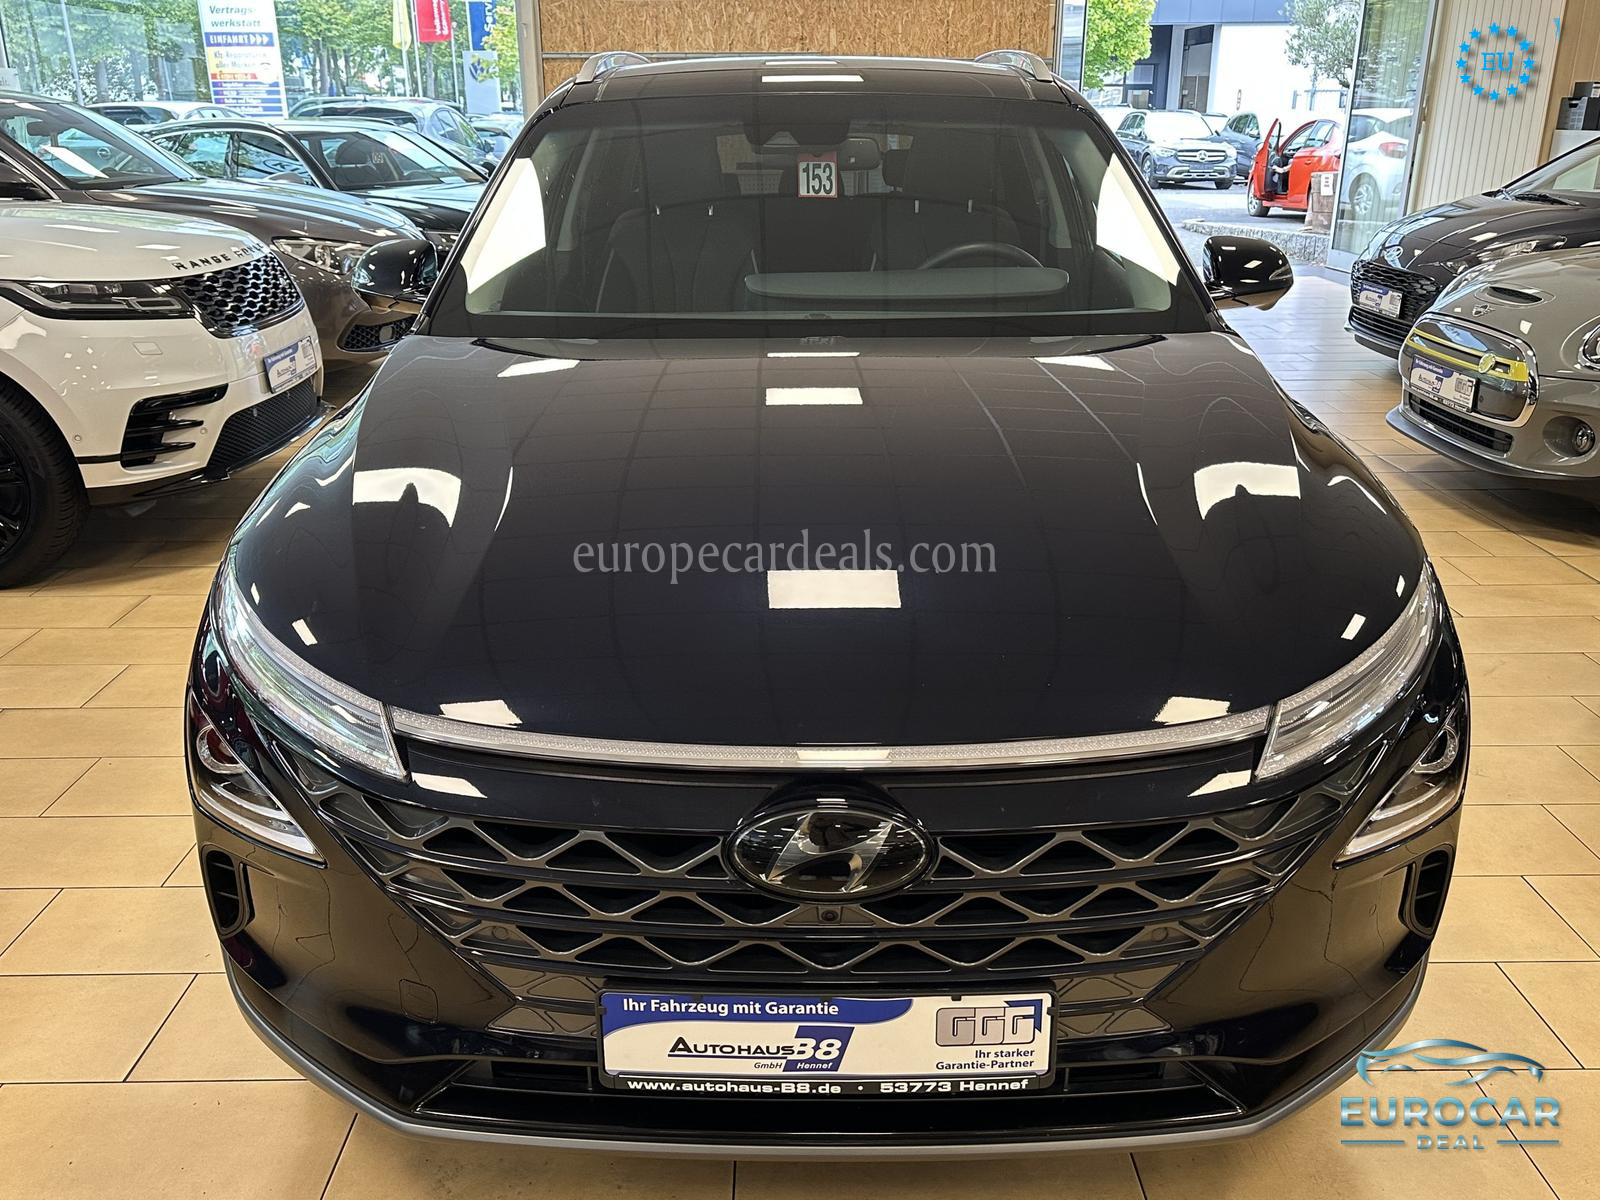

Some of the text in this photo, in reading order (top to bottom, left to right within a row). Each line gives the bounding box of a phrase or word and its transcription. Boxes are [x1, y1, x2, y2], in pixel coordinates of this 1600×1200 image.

[211, 19, 261, 28] werkstatt
[209, 34, 249, 44] EINFAHRT
[802, 163, 833, 195] 153
[172, 253, 231, 270] RANGE
[623, 998, 839, 1016] Ihr Fahrzeug mit Garantie
[975, 1048, 1035, 1058] Ihr starker
[935, 1059, 1034, 1070] Garantie-Partner
[627, 1079, 1029, 1094] www.autohaus-B8.de 53773 Hennef
